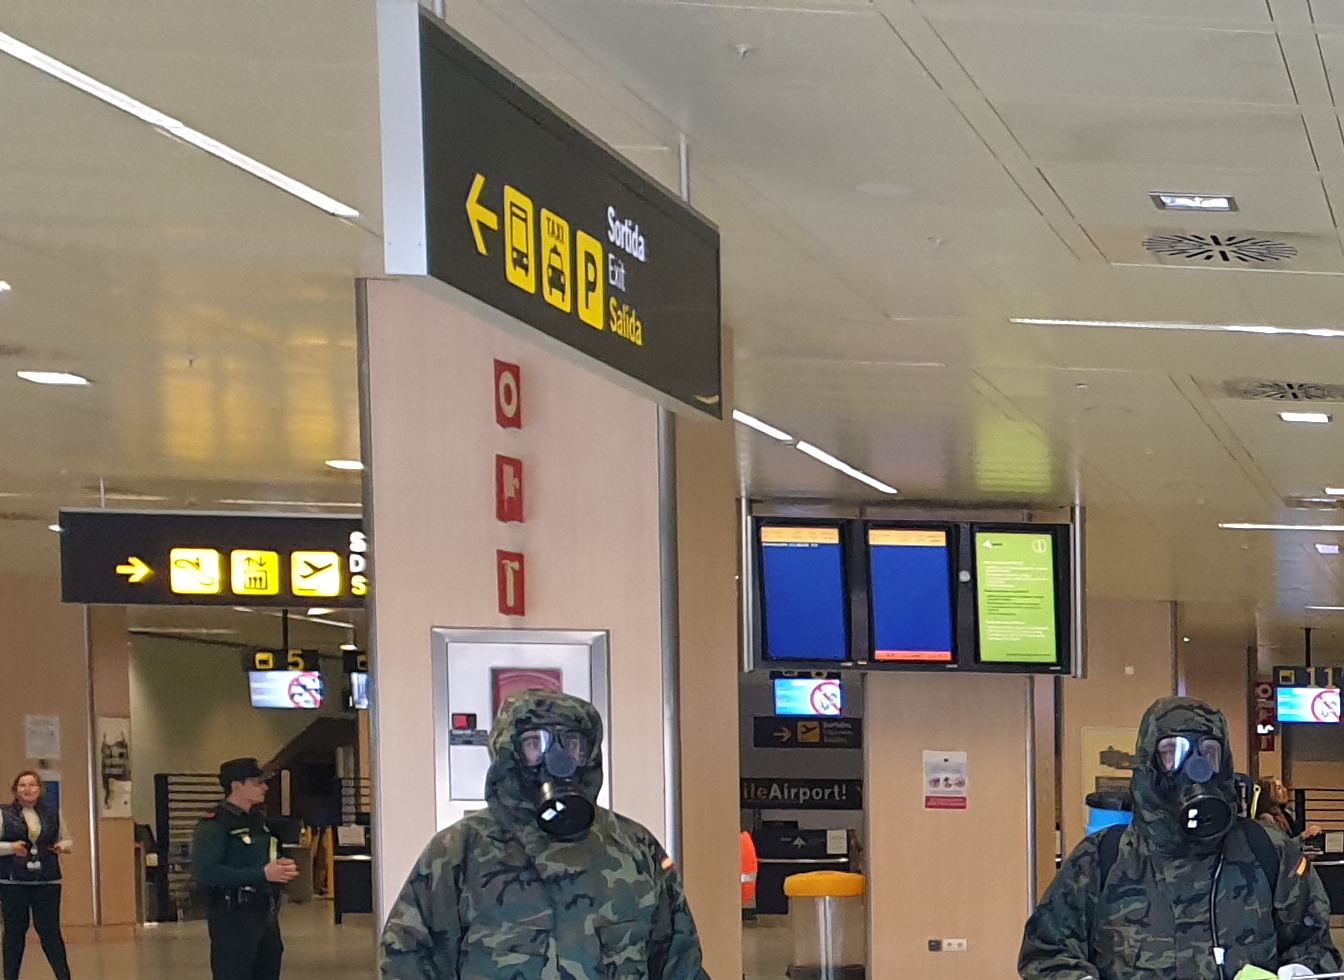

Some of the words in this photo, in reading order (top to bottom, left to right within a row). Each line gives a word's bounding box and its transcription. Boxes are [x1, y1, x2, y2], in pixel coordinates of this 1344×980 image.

[546, 216, 565, 245] TAXI
[606, 206, 646, 262] Sortida
[608, 253, 626, 292] Exit
[609, 296, 644, 346] Salida
[288, 651, 306, 672] 5
[1306, 666, 1337, 689] 11
